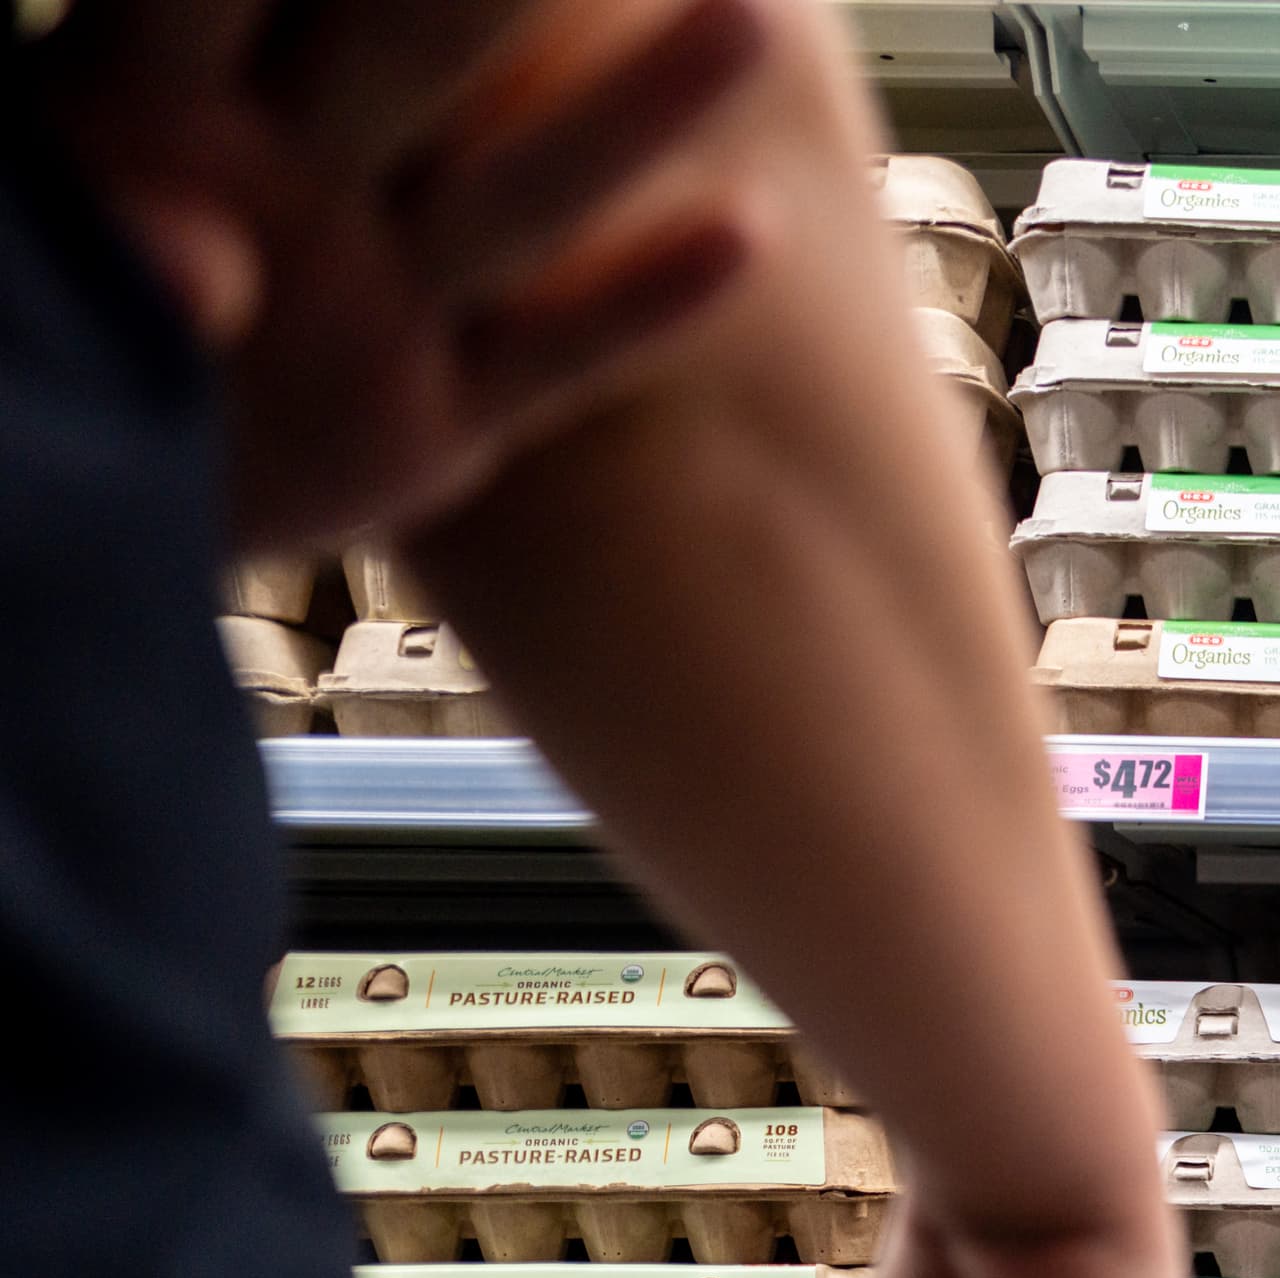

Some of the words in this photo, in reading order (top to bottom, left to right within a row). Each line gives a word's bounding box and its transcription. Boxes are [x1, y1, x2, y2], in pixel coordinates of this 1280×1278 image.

[1160, 188, 1239, 212] Organics
[1161, 344, 1239, 366] Organics
[1163, 500, 1241, 525] Organics
[1172, 644, 1251, 669] Organics
[1062, 784, 1089, 794] Eggs
[296, 976, 316, 989] 12
[318, 976, 342, 988] EGGS
[517, 981, 572, 989] ORGANIC
[450, 991, 635, 1006] PASTURE-RAISED
[765, 1124, 799, 1136] 108
[525, 1138, 579, 1147] ORGANIC
[459, 1148, 642, 1165] PASTURE-RAISED
